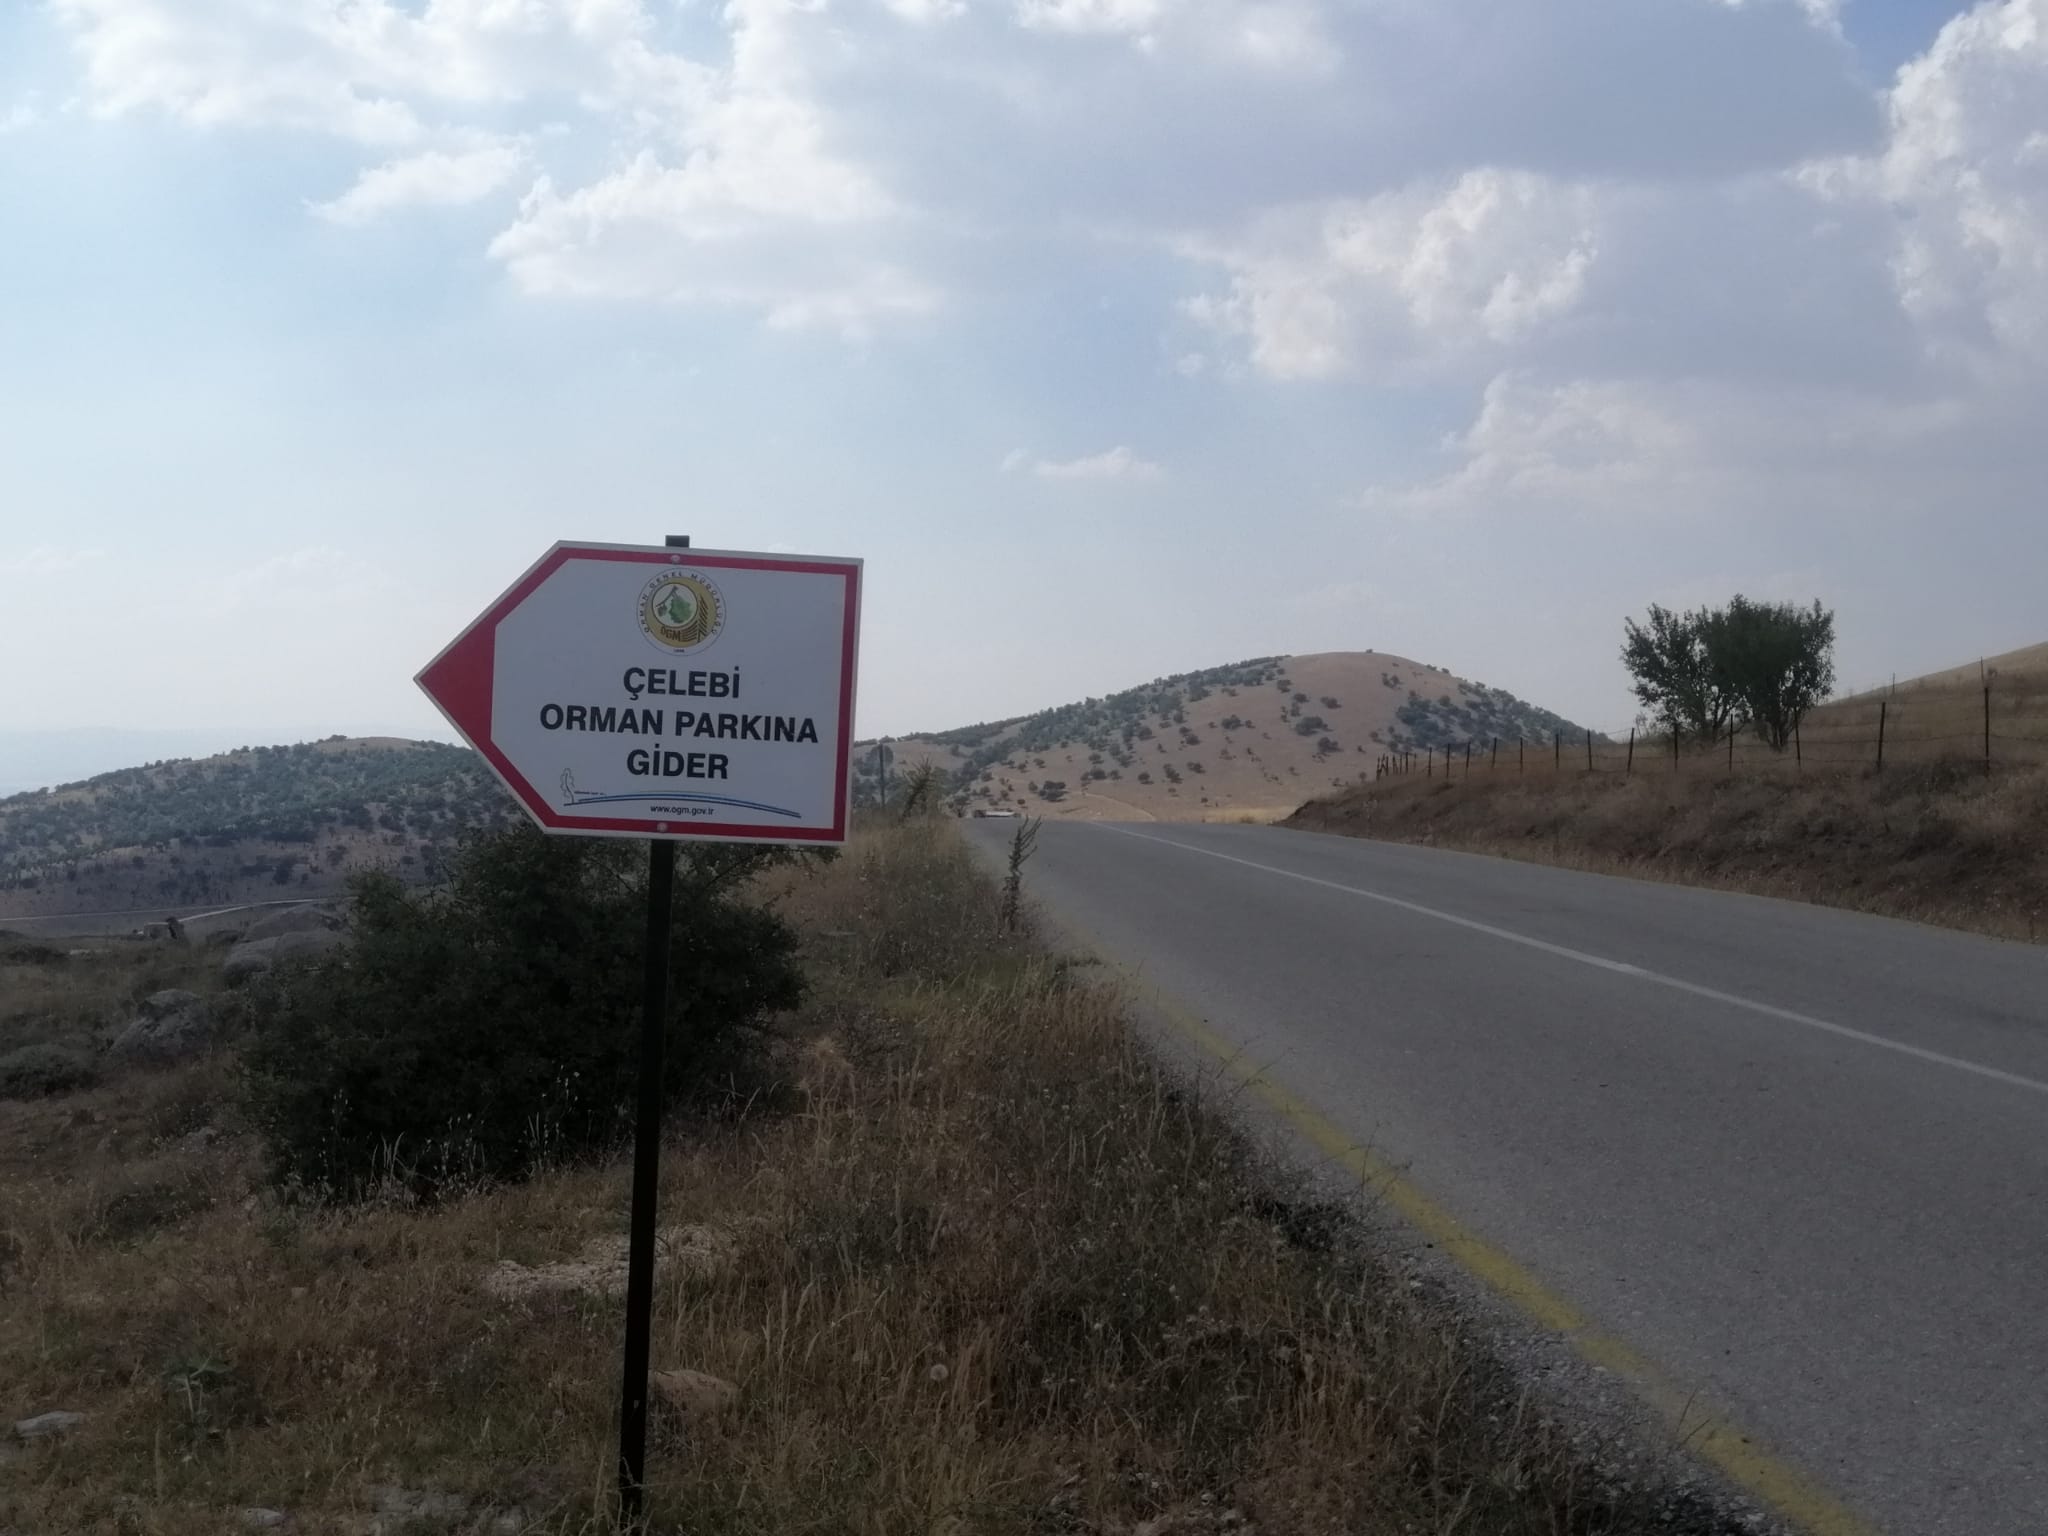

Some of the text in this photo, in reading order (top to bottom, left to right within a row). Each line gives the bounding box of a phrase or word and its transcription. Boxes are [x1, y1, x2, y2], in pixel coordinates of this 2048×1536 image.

[660, 626, 681, 642] OGM
[624, 666, 740, 700] ÇELEBİ
[540, 704, 818, 743] ORMAN PARKINA
[627, 744, 729, 779] GİDER
[650, 804, 714, 816] www.ogm.gov.tr
